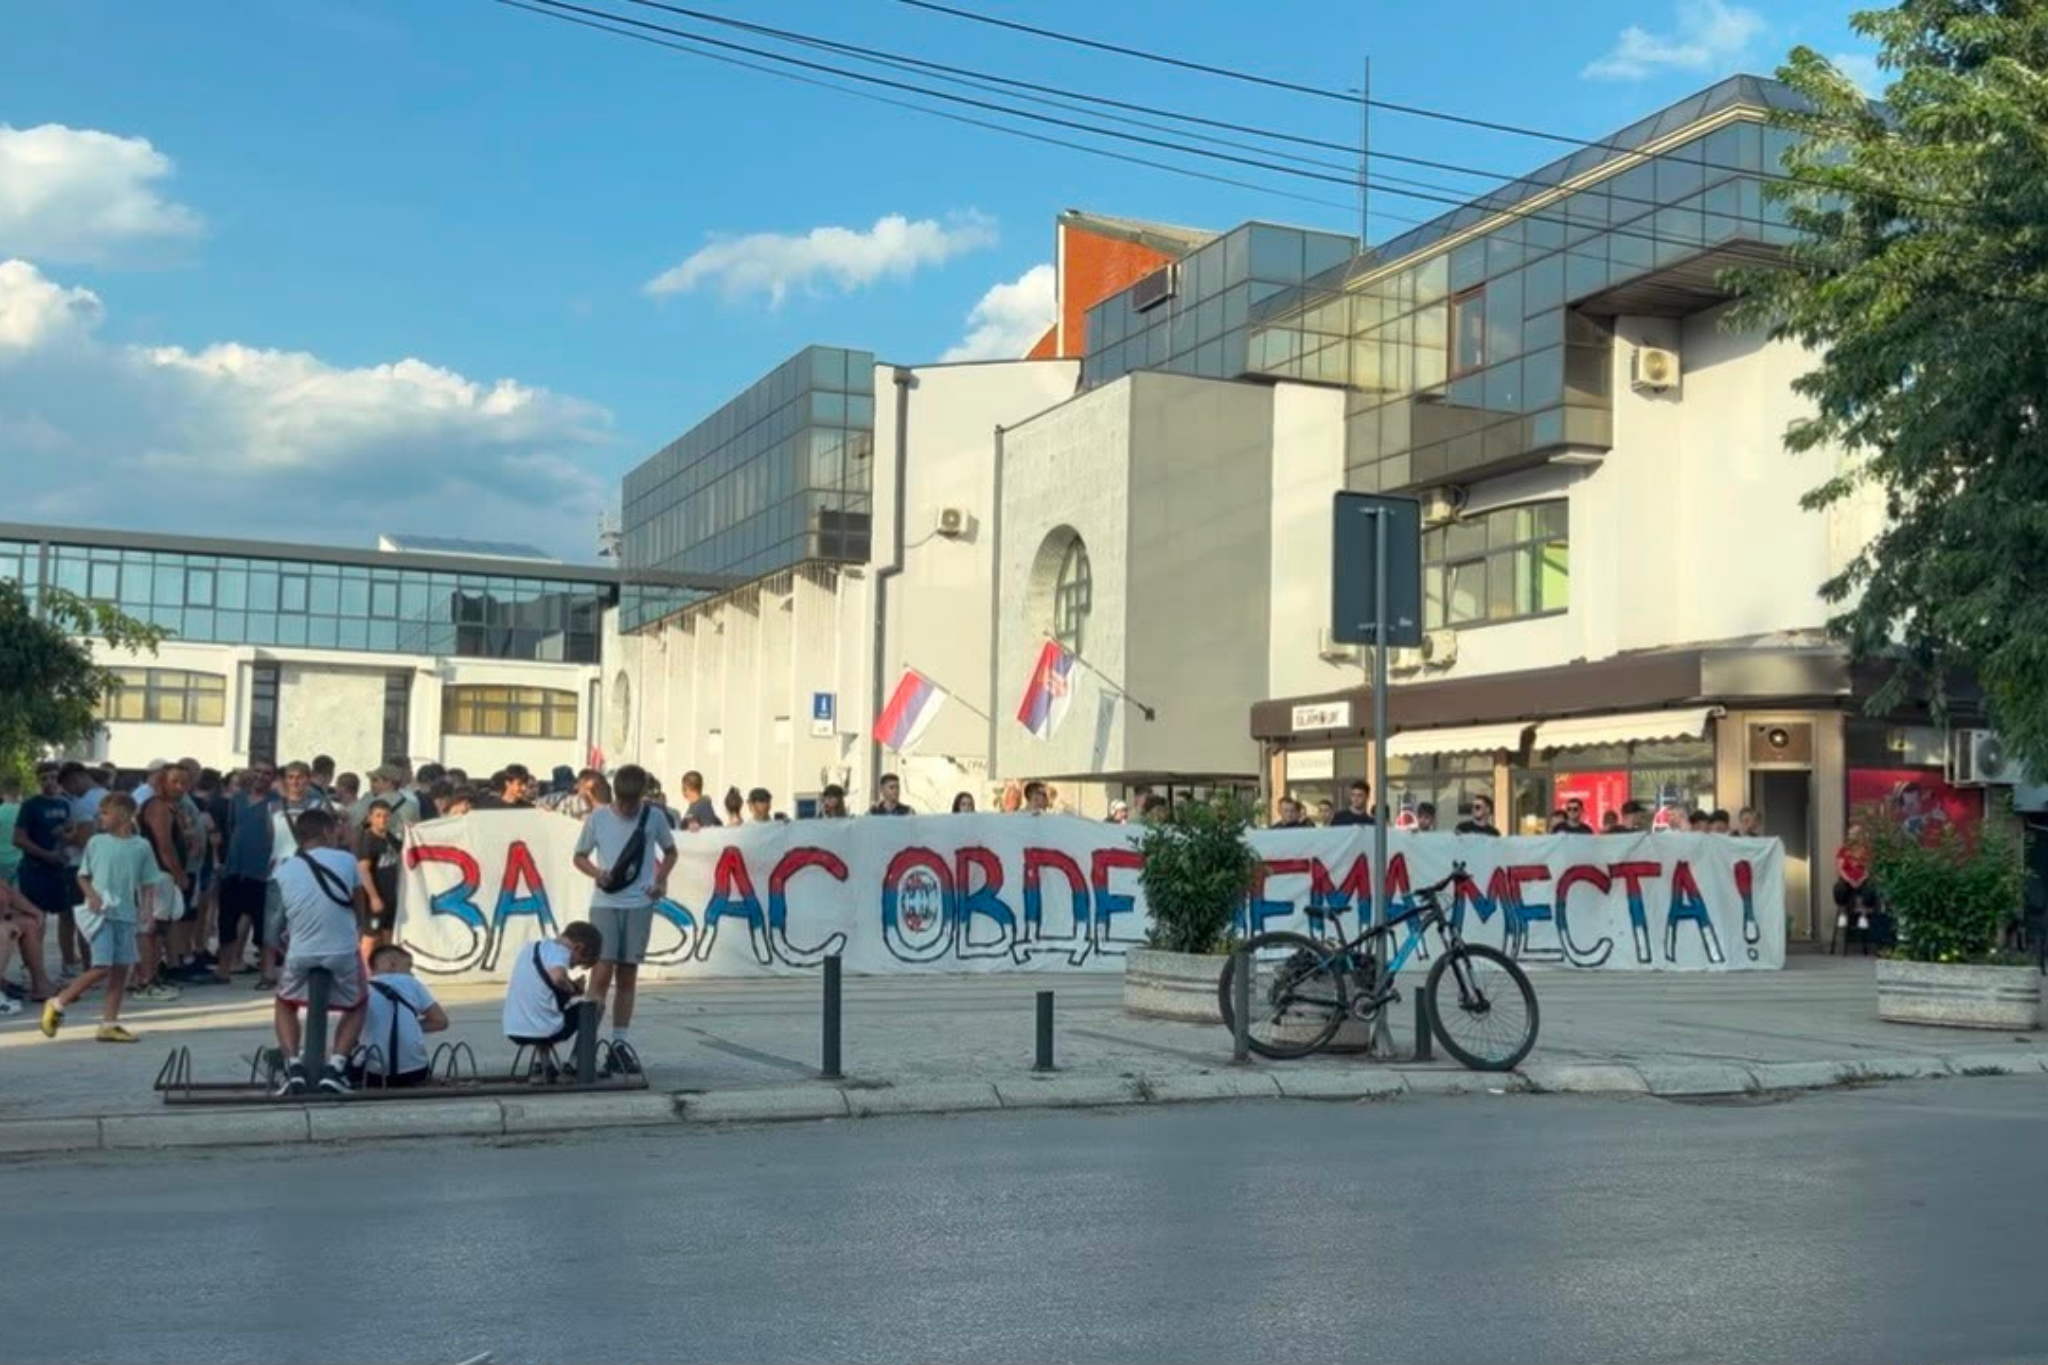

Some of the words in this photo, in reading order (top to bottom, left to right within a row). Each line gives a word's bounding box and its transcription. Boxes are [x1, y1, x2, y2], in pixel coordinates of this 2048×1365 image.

[403, 840, 560, 974] ЗА
[881, 846, 1150, 966] ОВДЕ
[1232, 852, 1430, 962] ЕМА
[1451, 860, 1761, 968] МЕСТА!
